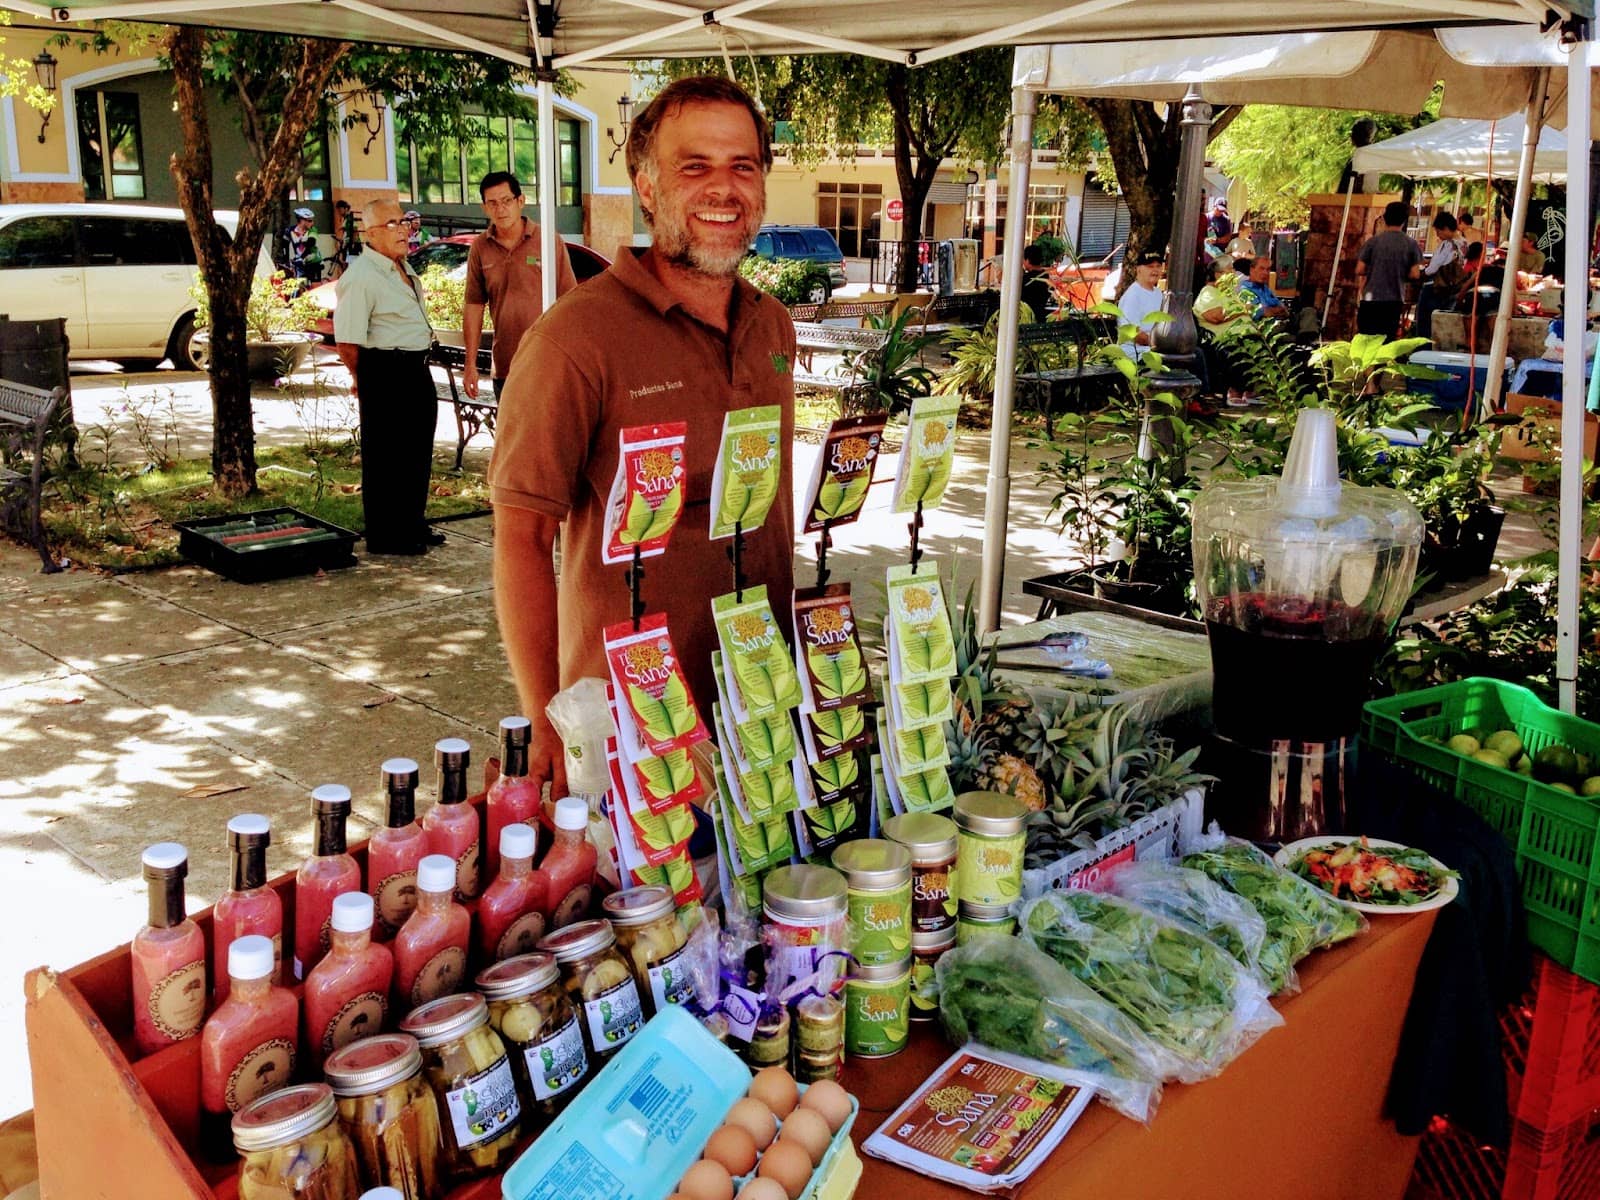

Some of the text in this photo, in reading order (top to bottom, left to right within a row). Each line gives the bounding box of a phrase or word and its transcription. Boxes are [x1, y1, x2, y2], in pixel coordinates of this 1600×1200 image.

[731, 450, 771, 473] Sana
[831, 454, 868, 475] Sana
[635, 470, 677, 495] Sana
[731, 632, 774, 655] Sana
[807, 624, 849, 646] Sana
[624, 664, 672, 687] Sana
[914, 884, 949, 900] Sana
[864, 914, 902, 931] Sana
[860, 1006, 898, 1022] Sana
[935, 1093, 998, 1134] Sana
